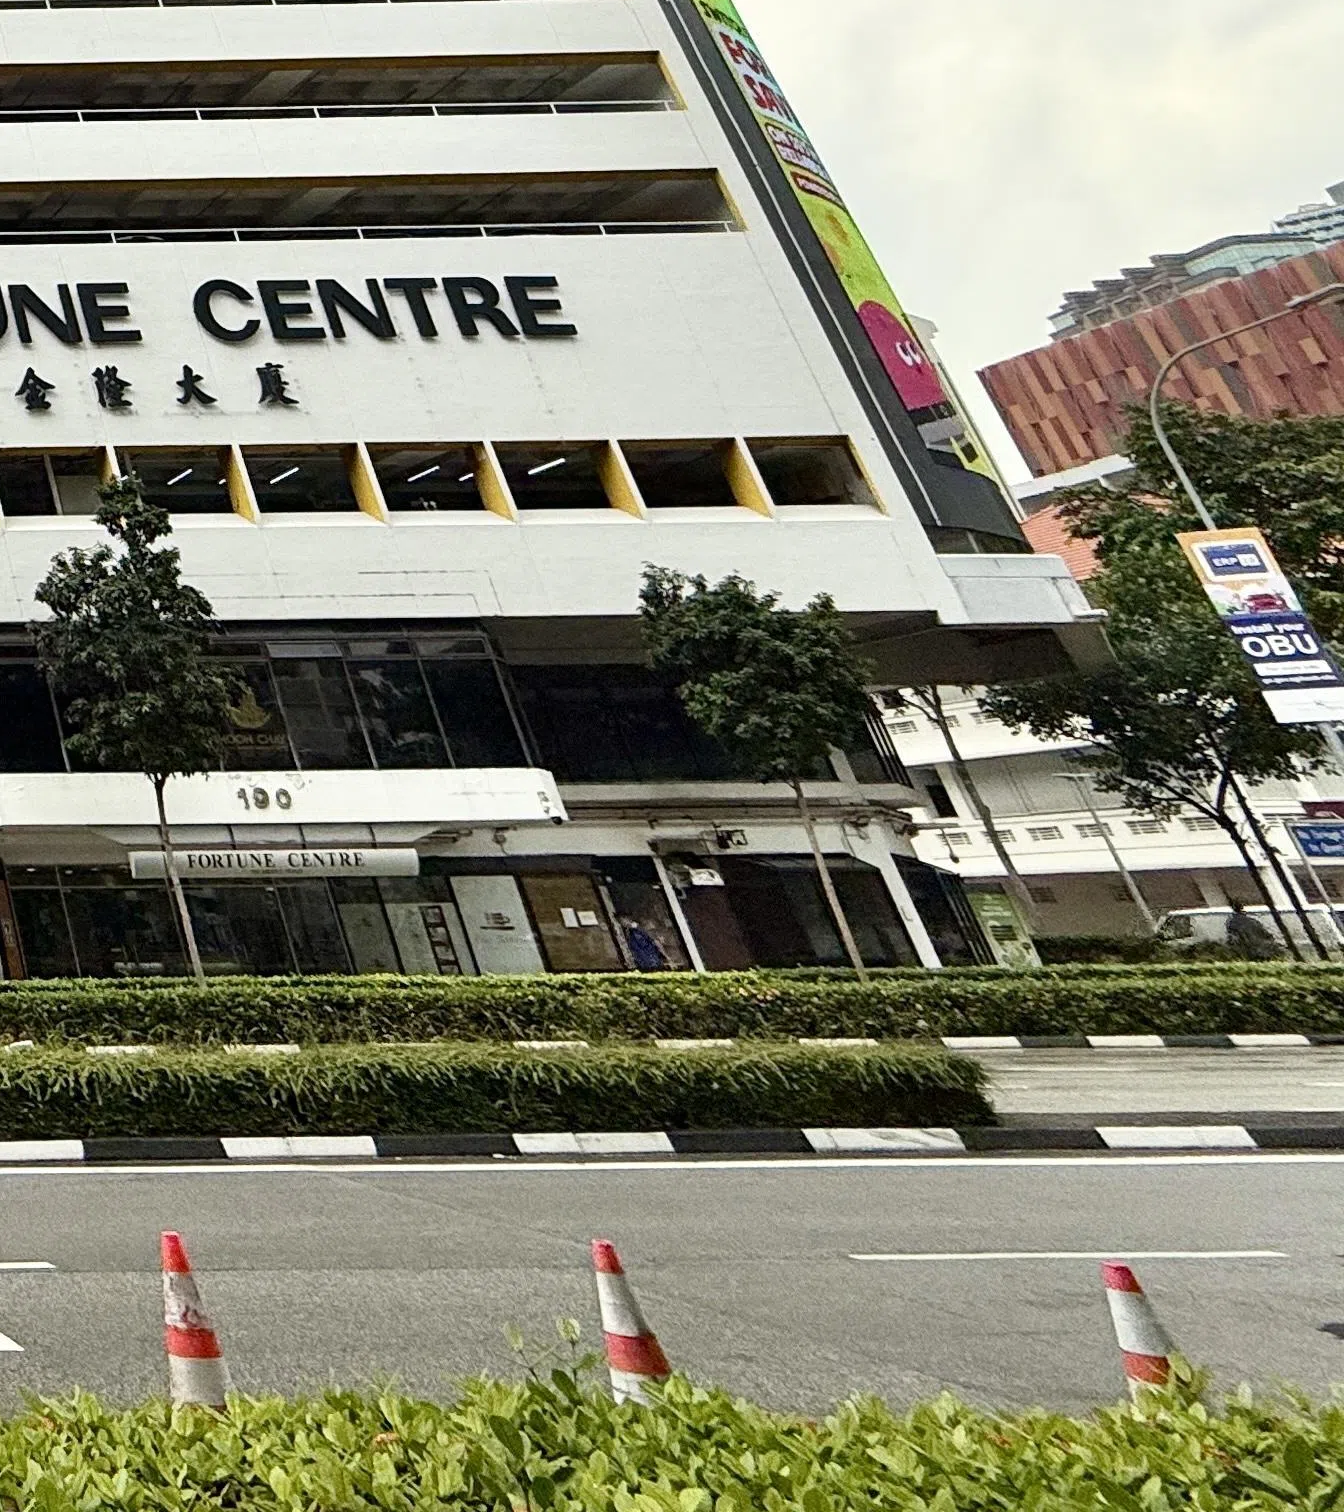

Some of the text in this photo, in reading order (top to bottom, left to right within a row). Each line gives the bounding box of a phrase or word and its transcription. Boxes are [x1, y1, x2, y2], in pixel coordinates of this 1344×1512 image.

[193, 274, 578, 344] CENTRE
[1241, 633, 1320, 658] OBU
[237, 787, 293, 810] 190
[187, 851, 366, 869] FORTUNE CENTRE
